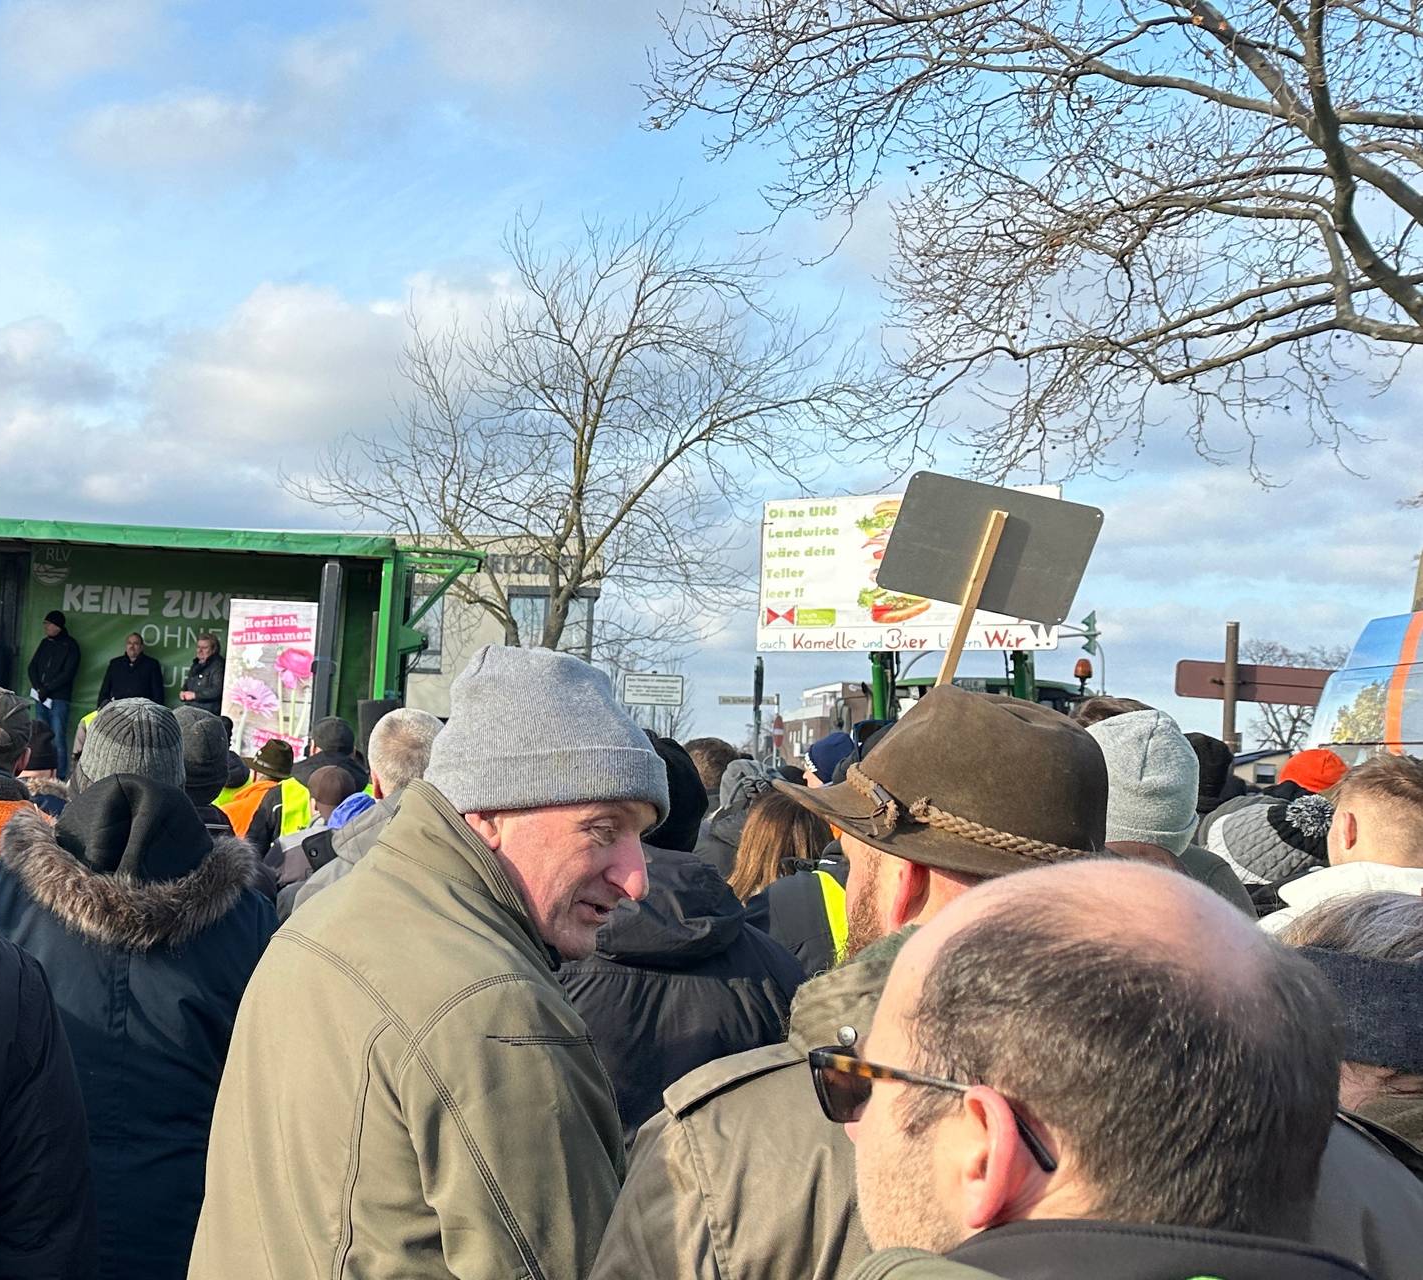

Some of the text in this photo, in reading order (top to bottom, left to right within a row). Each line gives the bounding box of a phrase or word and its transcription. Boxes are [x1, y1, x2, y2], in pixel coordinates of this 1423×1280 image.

[809, 506, 838, 517] UNS
[768, 527, 839, 539] Landwirte
[46, 548, 72, 562] RLV
[766, 546, 835, 558] wäre dein
[765, 568, 804, 579] Teller
[63, 584, 152, 616] KEINE
[245, 616, 297, 628] Herzlich
[232, 631, 311, 643] willkommen
[760, 634, 786, 649] auch
[793, 631, 856, 650] Kamelle
[862, 634, 883, 648] und
[884, 628, 928, 649] Bier
[985, 629, 1026, 649] Wir
